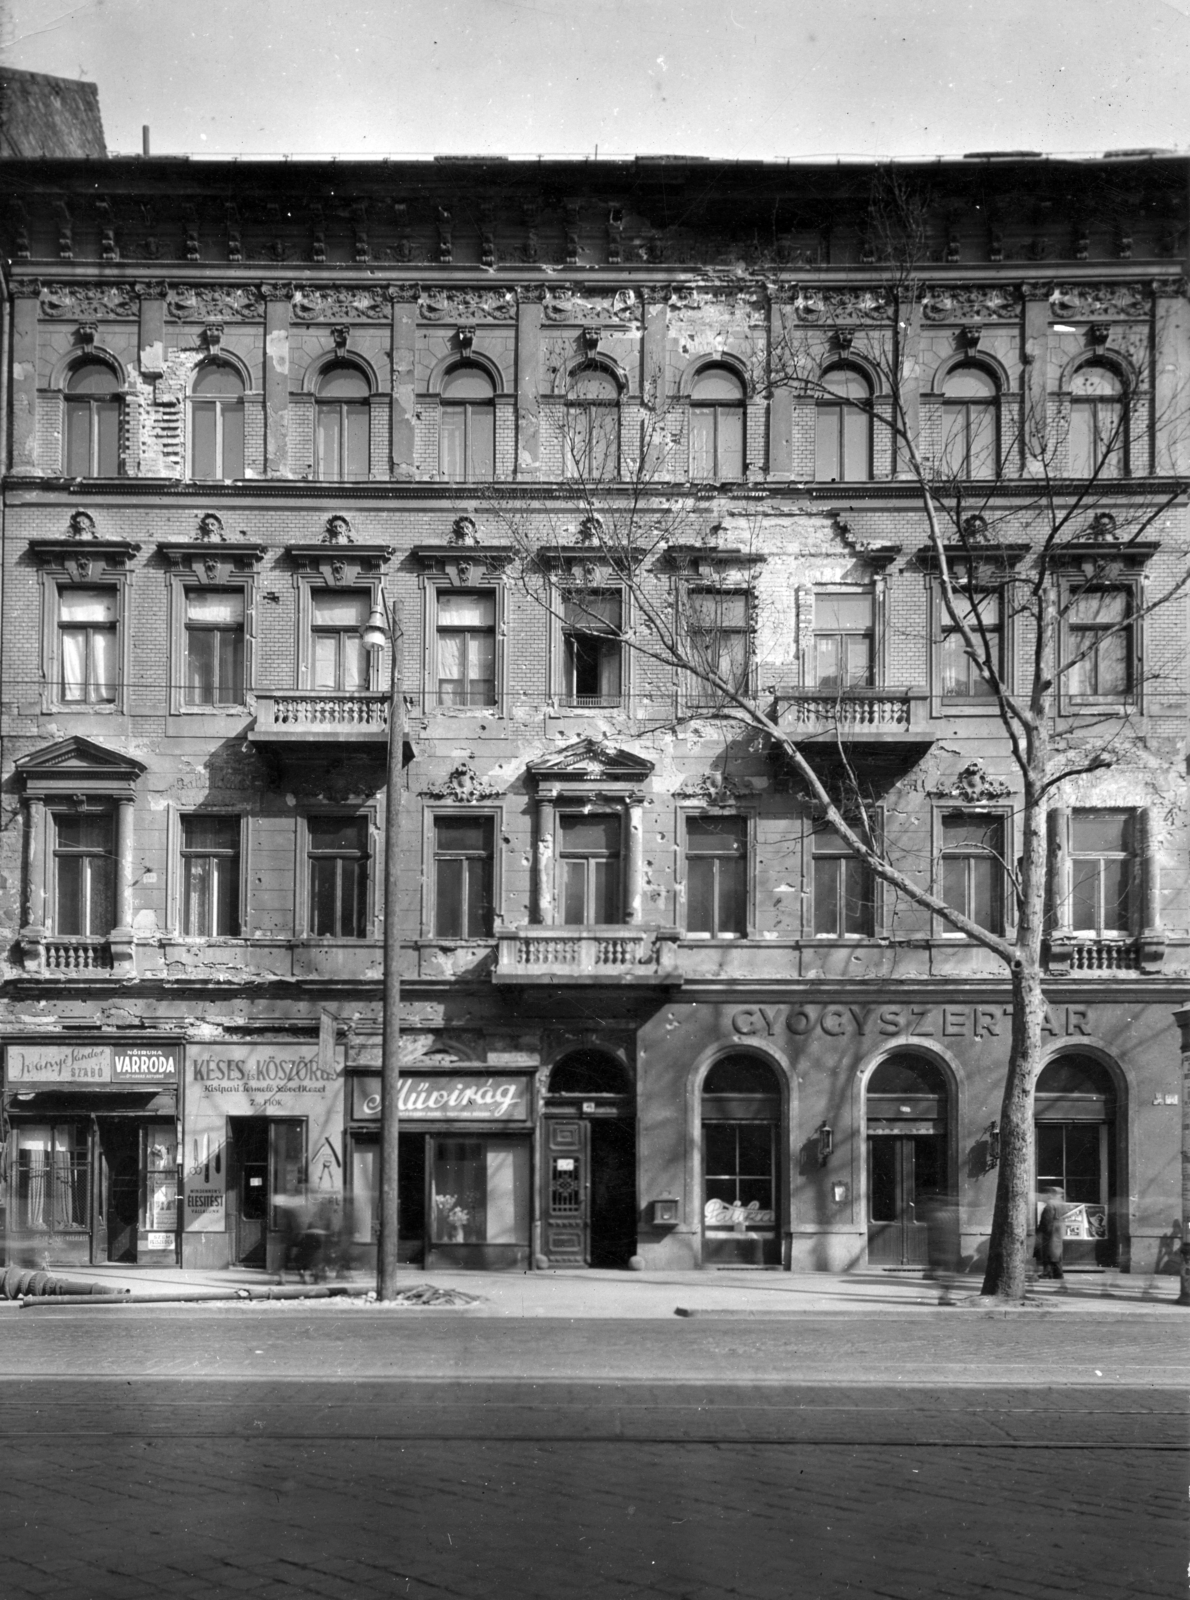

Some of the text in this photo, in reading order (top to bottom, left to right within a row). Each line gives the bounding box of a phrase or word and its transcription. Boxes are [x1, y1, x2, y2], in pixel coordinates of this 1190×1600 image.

[70, 1062, 103, 1078] SZABÓ
[114, 1056, 175, 1073] VARRODA
[192, 1054, 245, 1082] KÉSES
